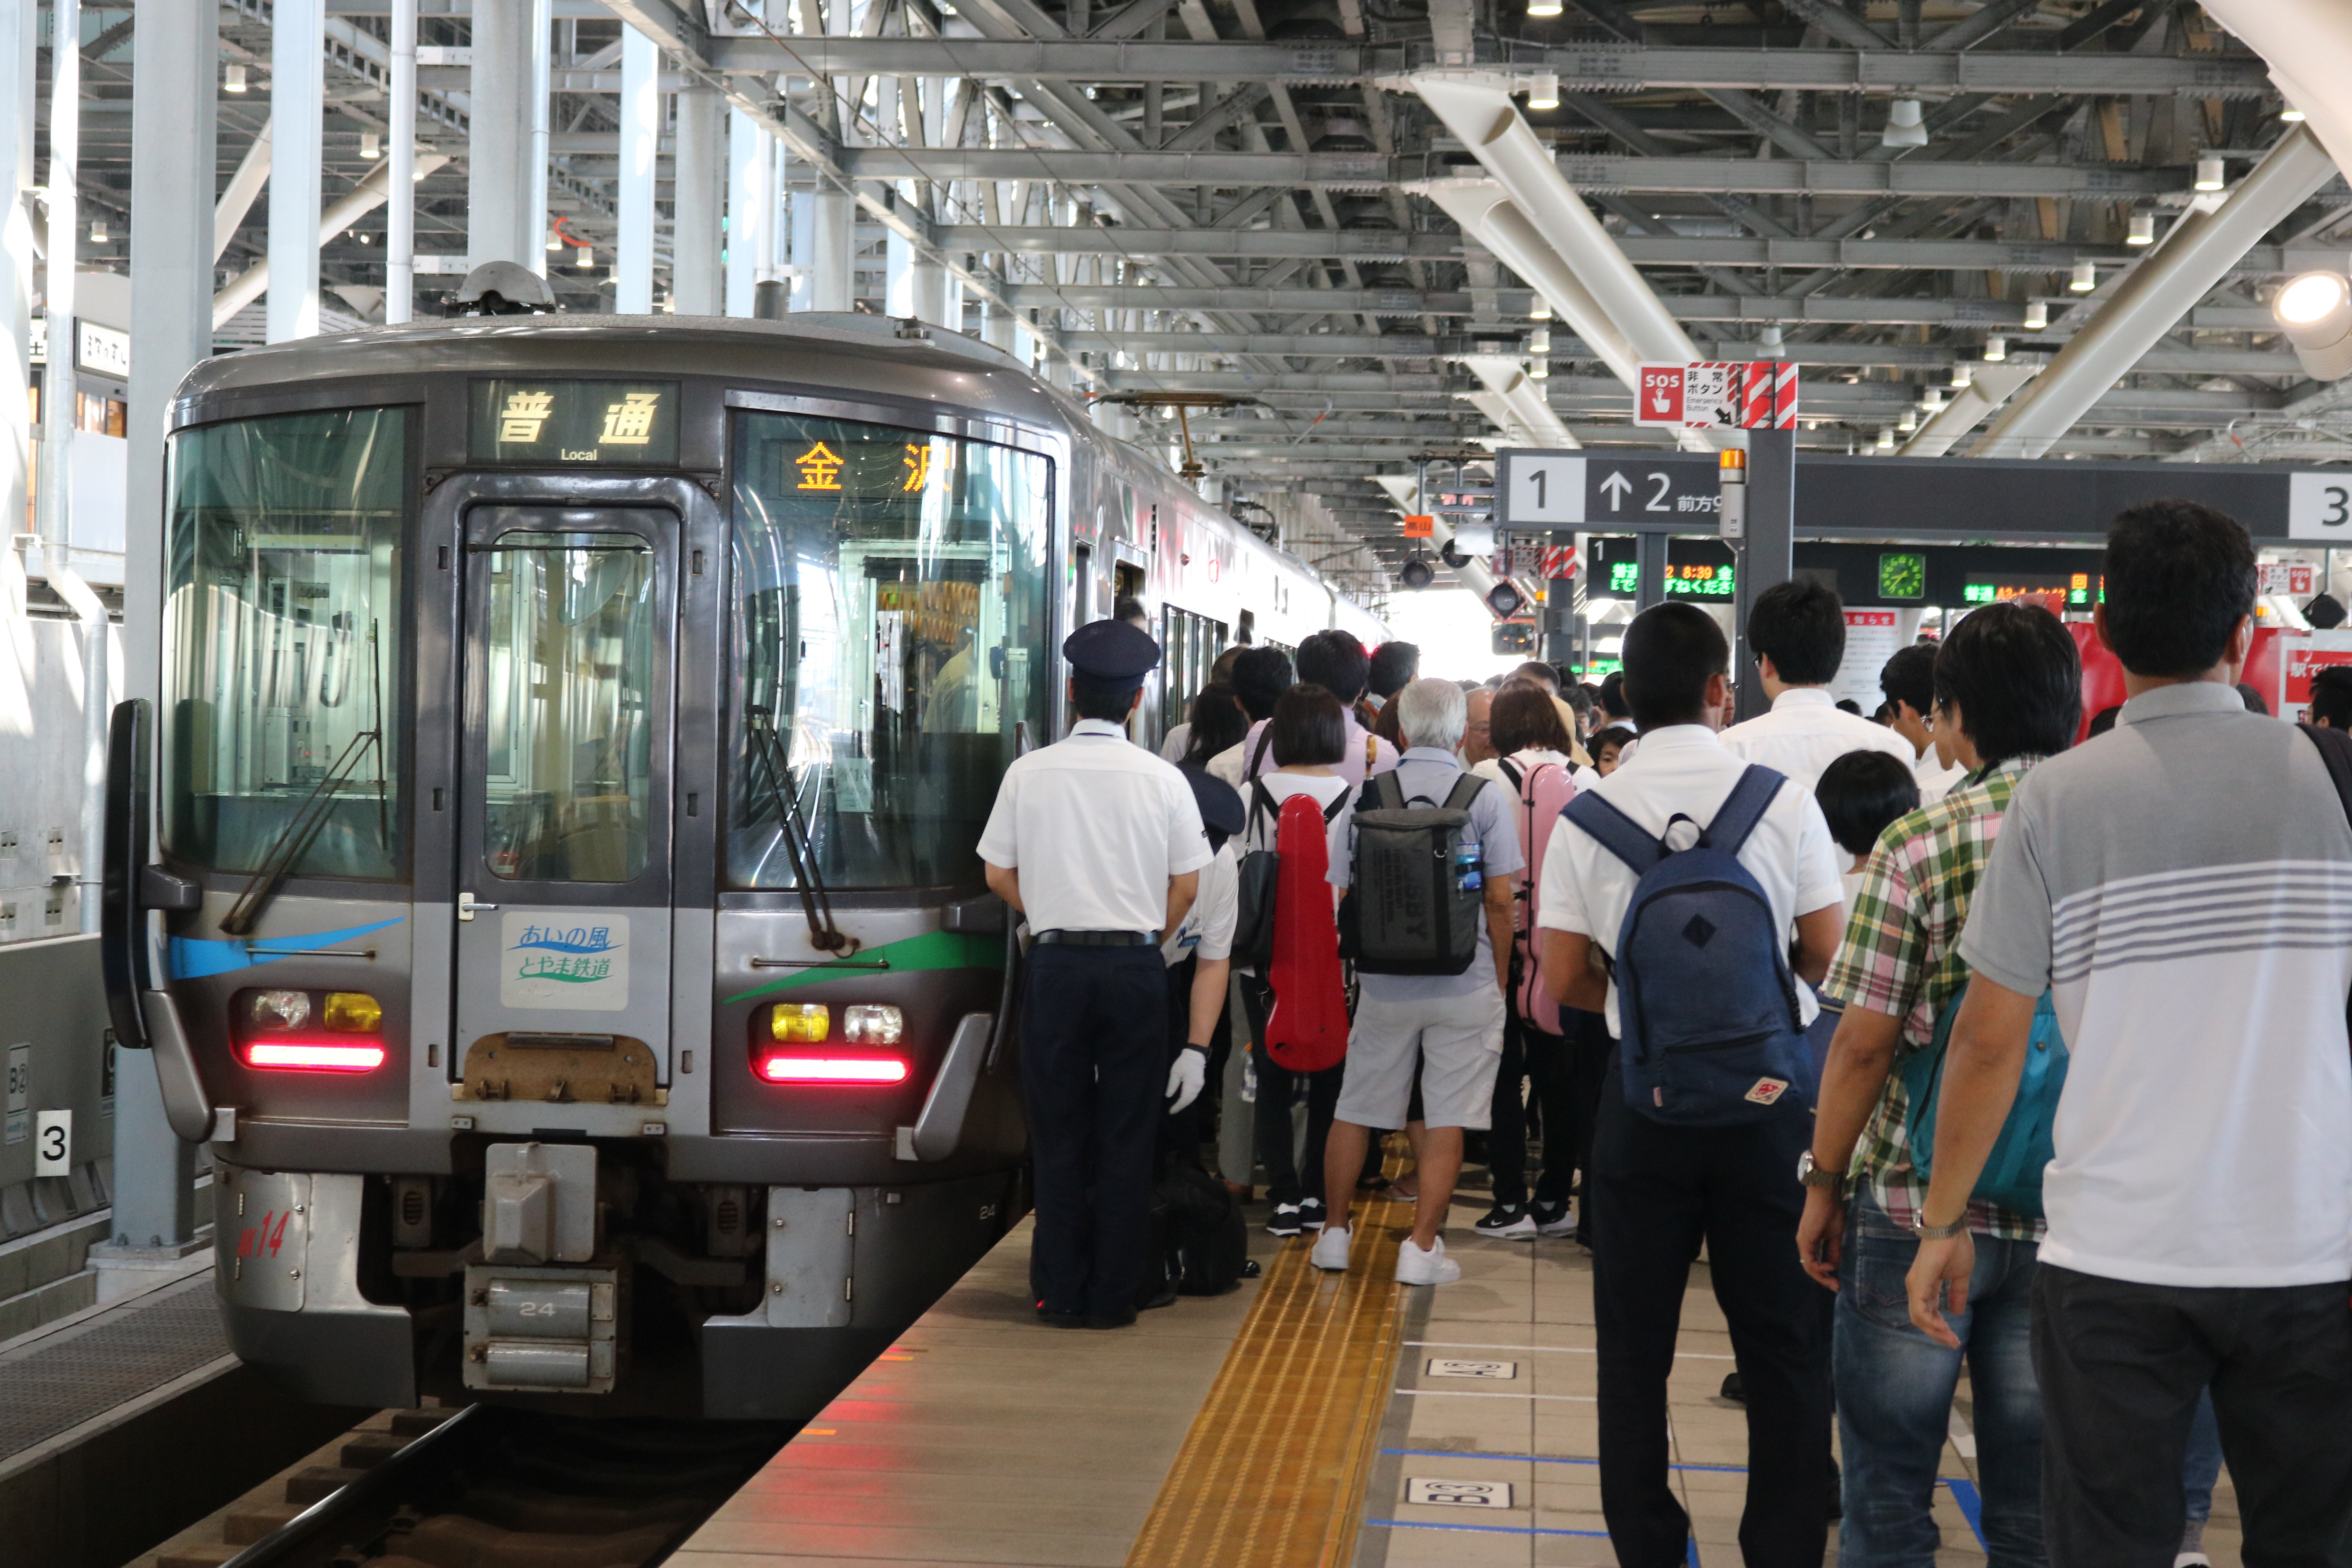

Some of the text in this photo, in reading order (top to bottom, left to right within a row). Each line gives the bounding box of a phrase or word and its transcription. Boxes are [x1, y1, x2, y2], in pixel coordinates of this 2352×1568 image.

[1646, 375, 1680, 388] SOS
[1688, 372, 1723, 383] 非常
[1688, 384, 1723, 394] ボタン
[500, 392, 661, 444] 普通
[561, 448, 597, 461] Local
[1529, 470, 1546, 509] 1
[1646, 473, 1671, 512] 2
[2322, 487, 2349, 526] 3
[1594, 540, 1604, 561] 1
[1682, 565, 1713, 579] 8:39
[519, 925, 611, 947] あいの風
[519, 956, 611, 977] とやま鉄道
[43, 1126, 65, 1161] 3
[980, 1203, 996, 1220] 24
[520, 1302, 556, 1317] 24
